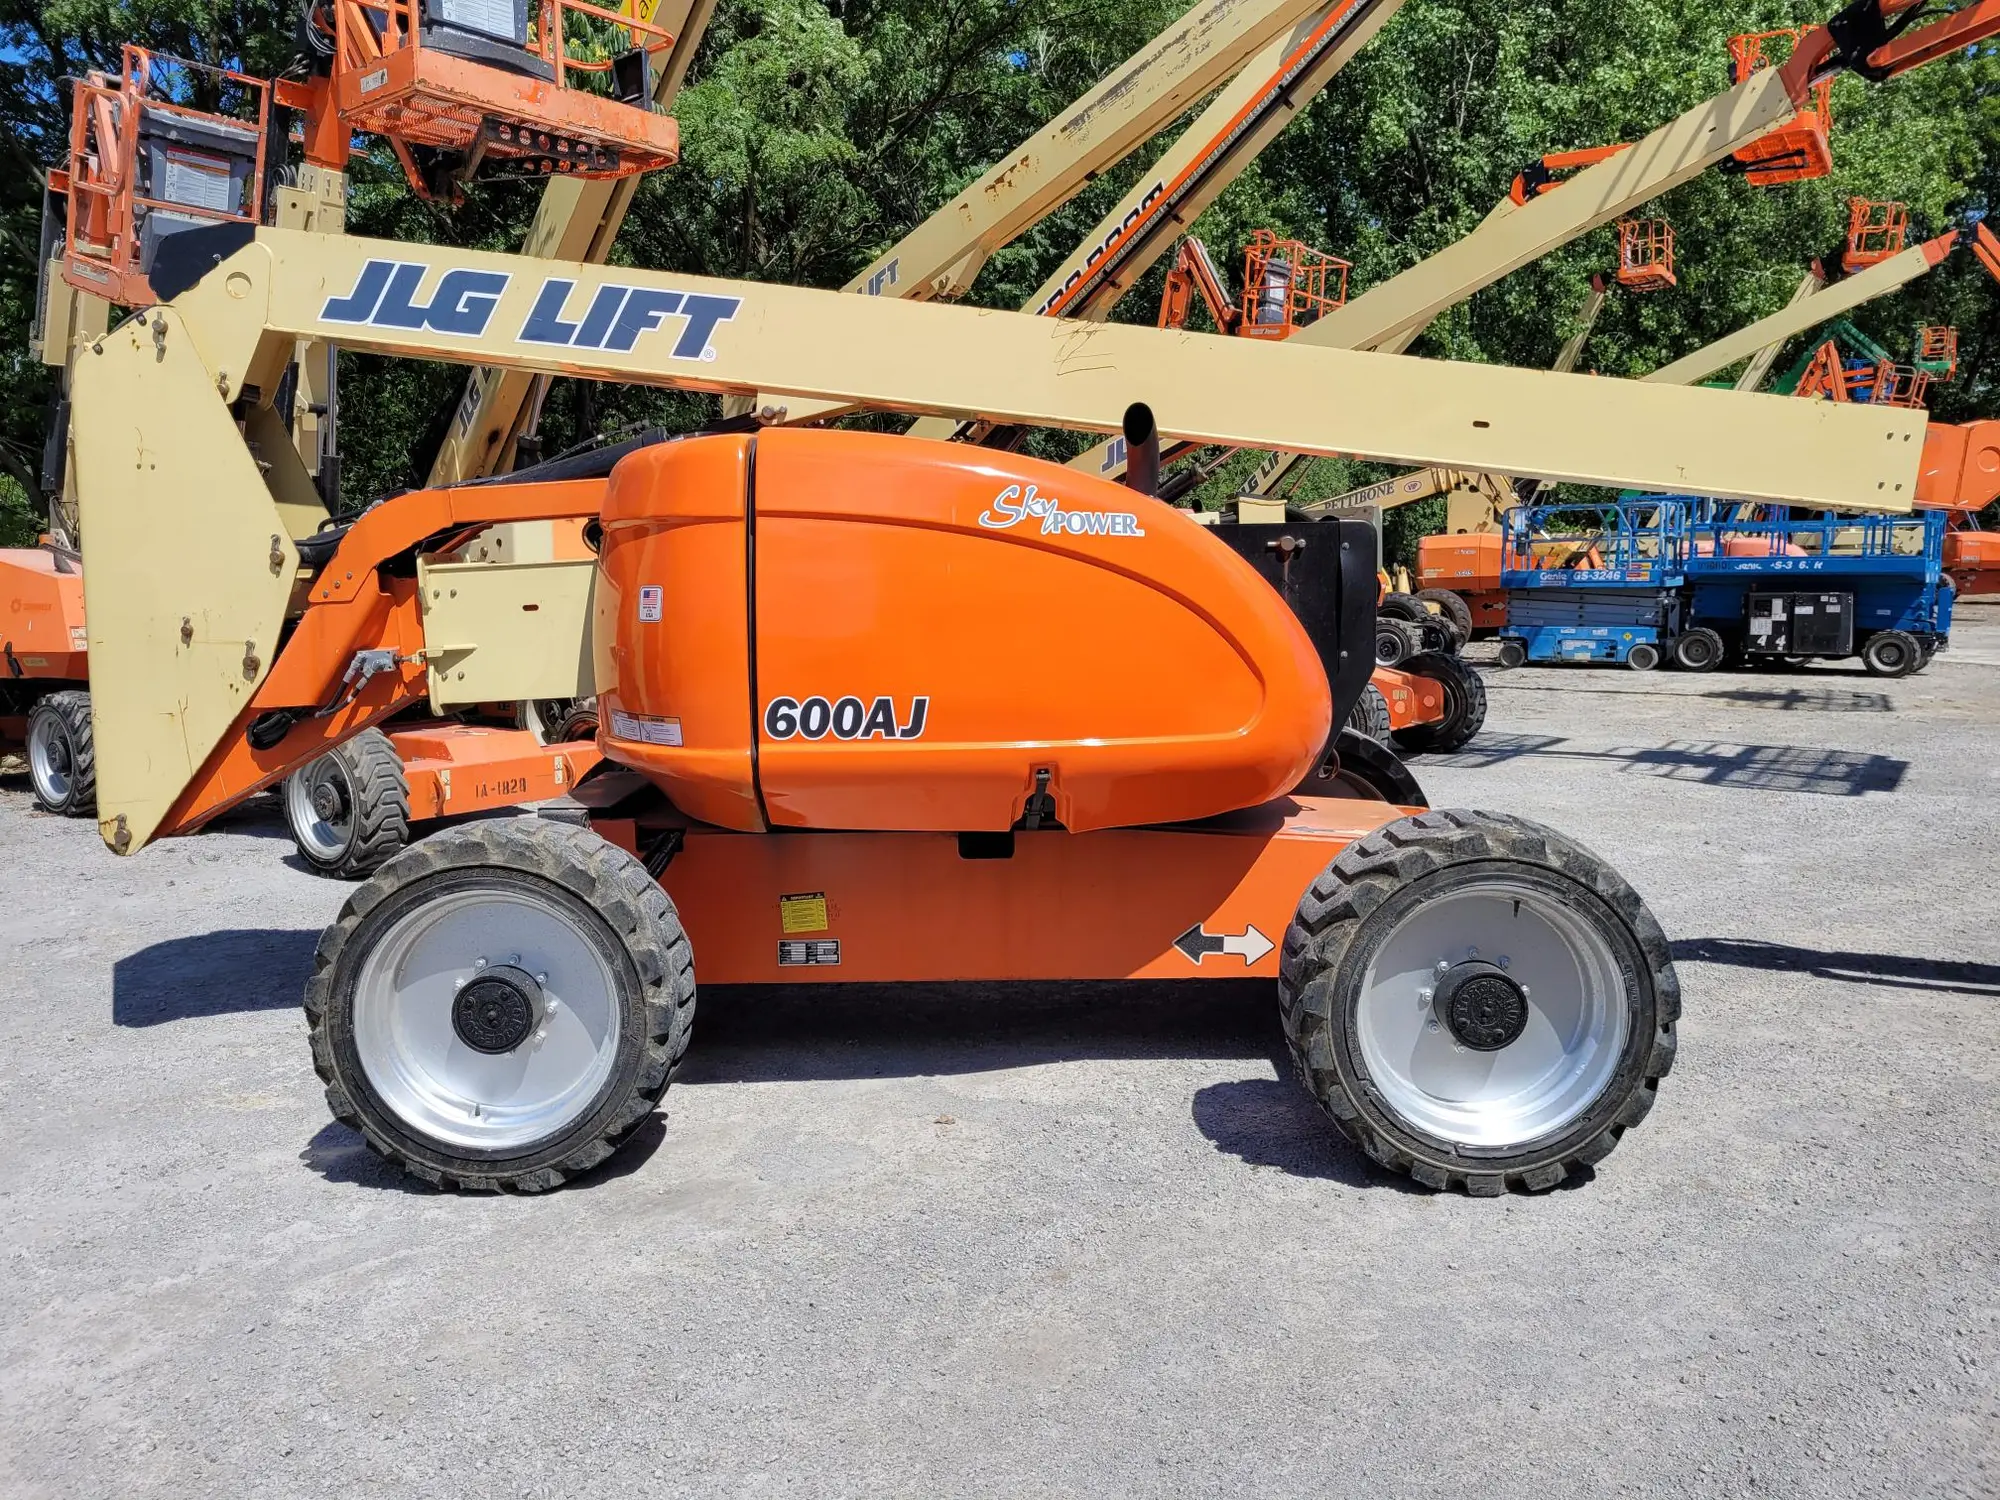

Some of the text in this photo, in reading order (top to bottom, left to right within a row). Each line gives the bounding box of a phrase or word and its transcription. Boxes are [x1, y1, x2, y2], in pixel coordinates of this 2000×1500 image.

[318, 258, 744, 359] JLG LIFT
[459, 377, 482, 441] JLG
[1260, 450, 1289, 479] LIF
[979, 485, 1137, 535] Sky POWER
[1324, 481, 1395, 511] PETTIBONE
[1539, 571, 1568, 581] Genie
[1572, 570, 1621, 581] GS-3246
[765, 697, 929, 740] 600AJ
